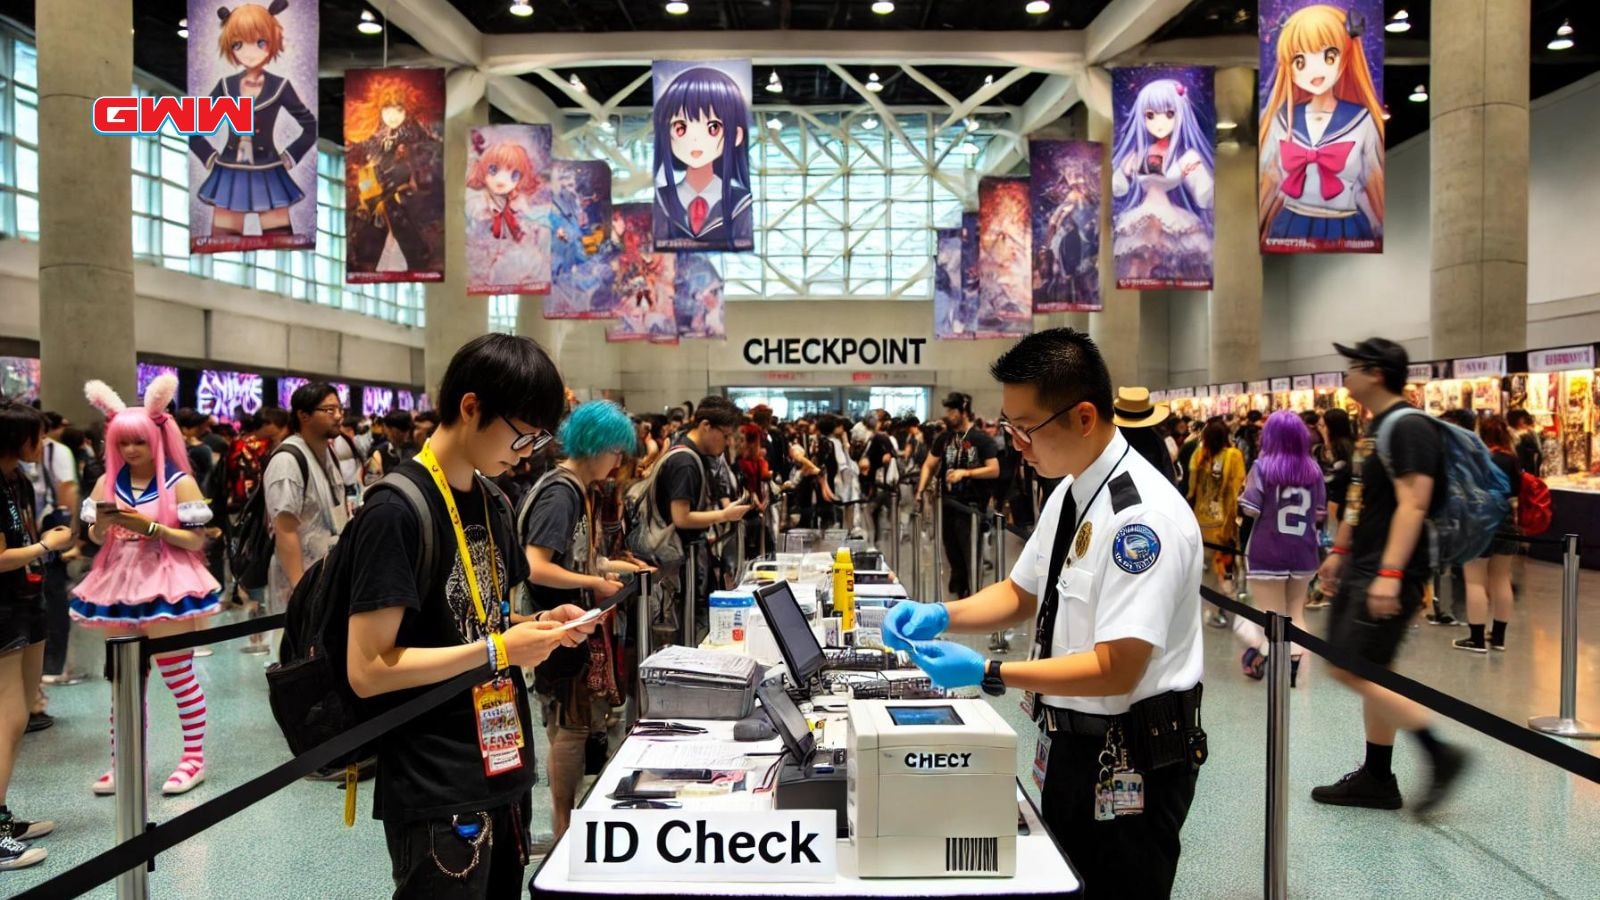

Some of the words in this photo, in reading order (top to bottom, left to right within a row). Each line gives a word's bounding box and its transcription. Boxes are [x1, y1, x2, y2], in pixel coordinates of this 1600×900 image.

[743, 338, 926, 364] CHECKPOINT
[197, 370, 263, 399] ANIME
[584, 821, 639, 863] ID
[656, 819, 821, 864] Check
